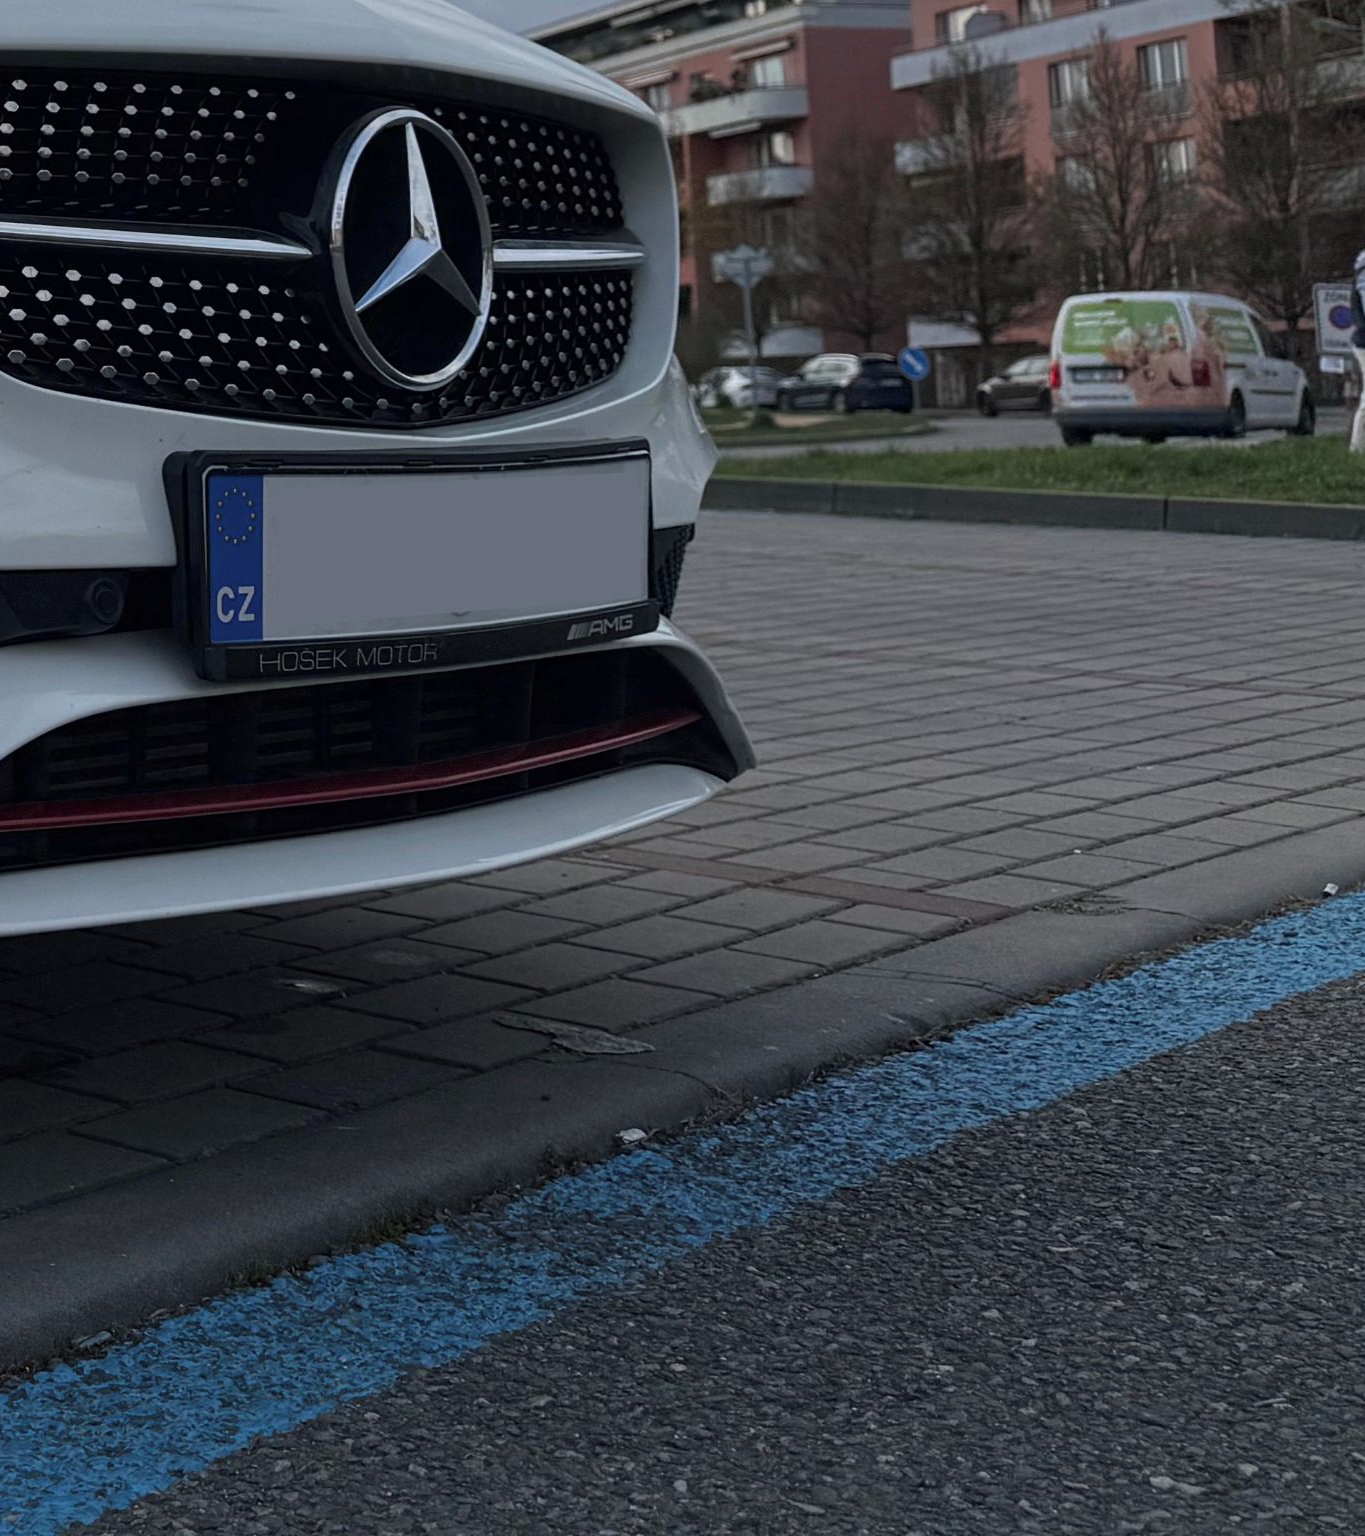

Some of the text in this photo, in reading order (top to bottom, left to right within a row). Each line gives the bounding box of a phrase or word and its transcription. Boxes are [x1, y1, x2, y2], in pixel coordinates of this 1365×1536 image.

[216, 585, 256, 624] CZ
[587, 614, 634, 637] AMG
[259, 641, 438, 673] HOŠEK MOTOR
